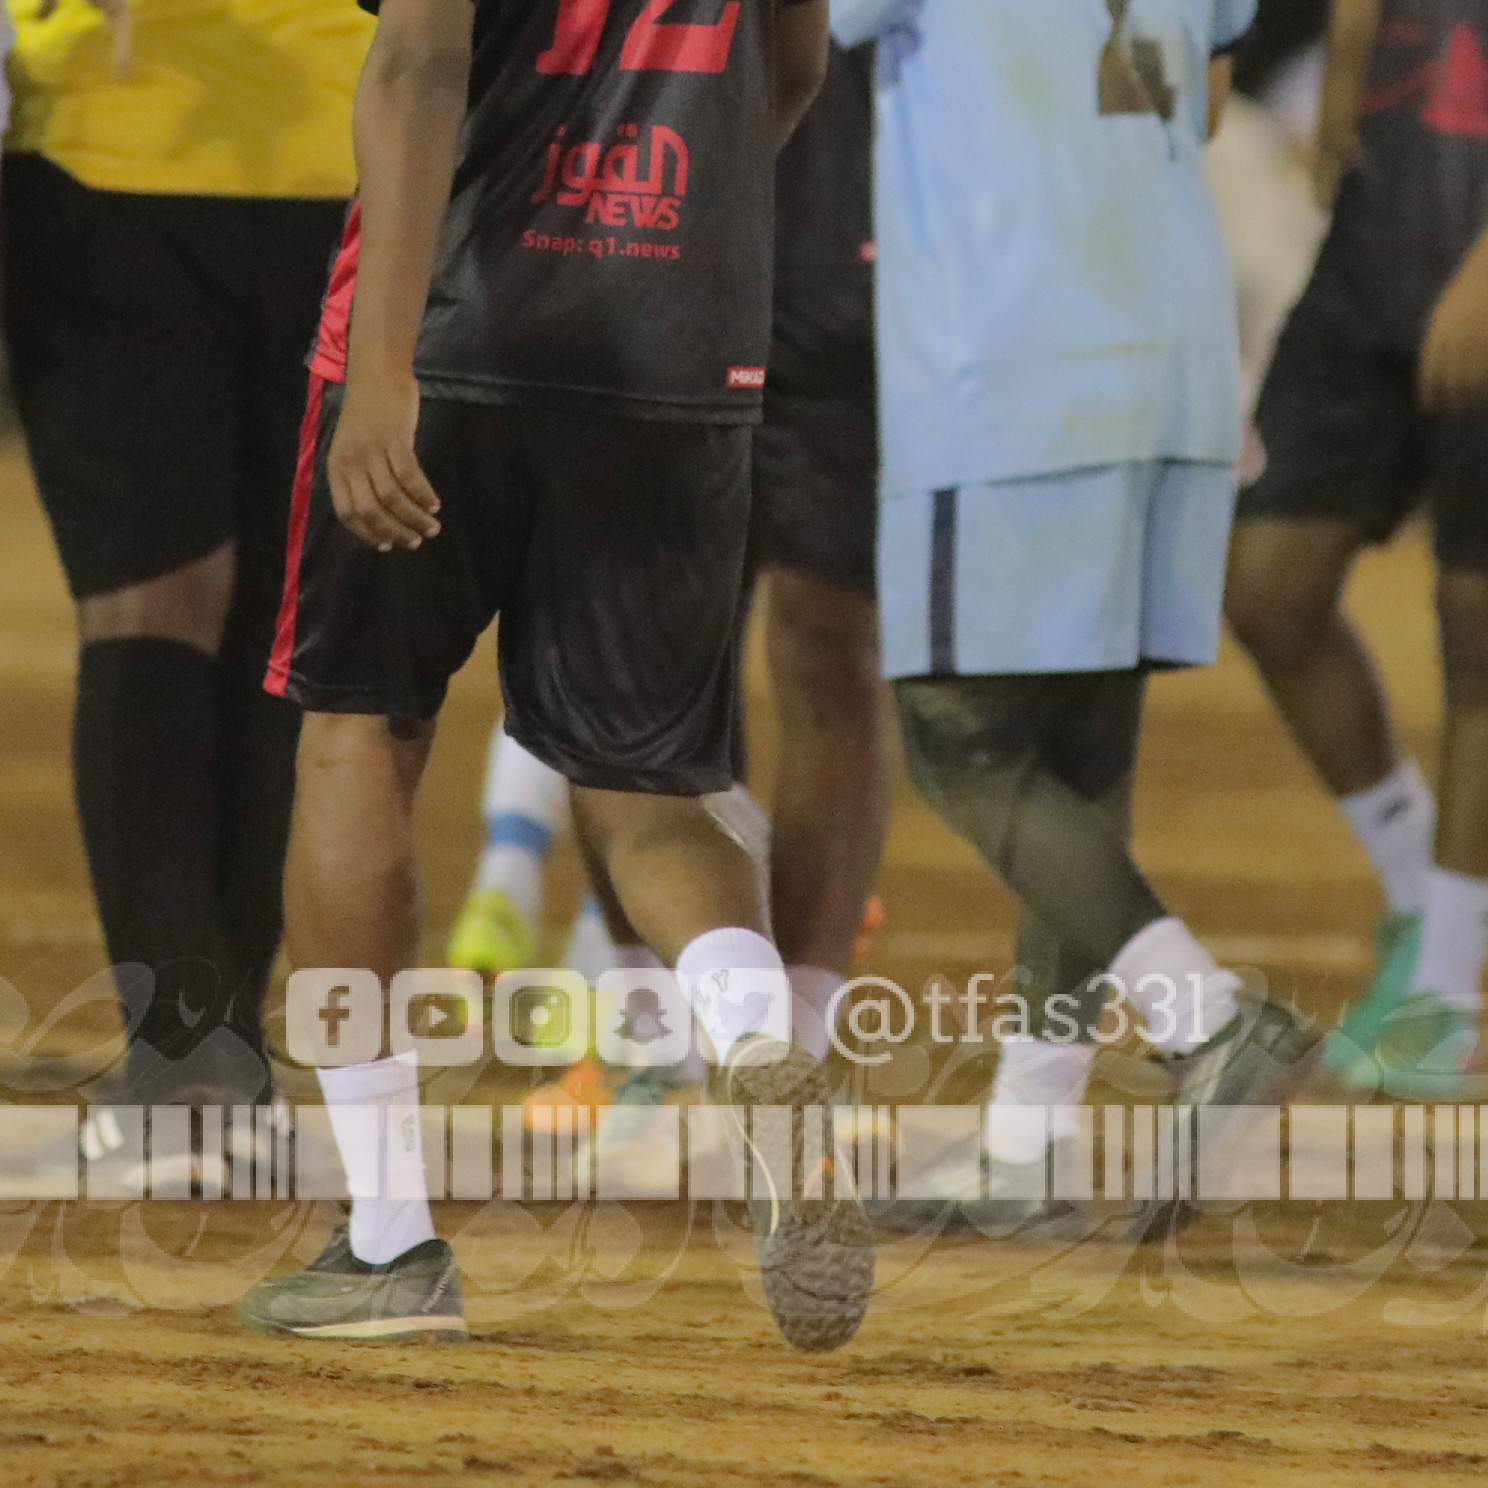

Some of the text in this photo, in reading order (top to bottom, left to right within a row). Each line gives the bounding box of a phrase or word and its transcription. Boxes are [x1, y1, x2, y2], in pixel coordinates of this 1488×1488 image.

[584, 191, 683, 232] NEWS
[521, 228, 683, 260] Snap: q1.news
